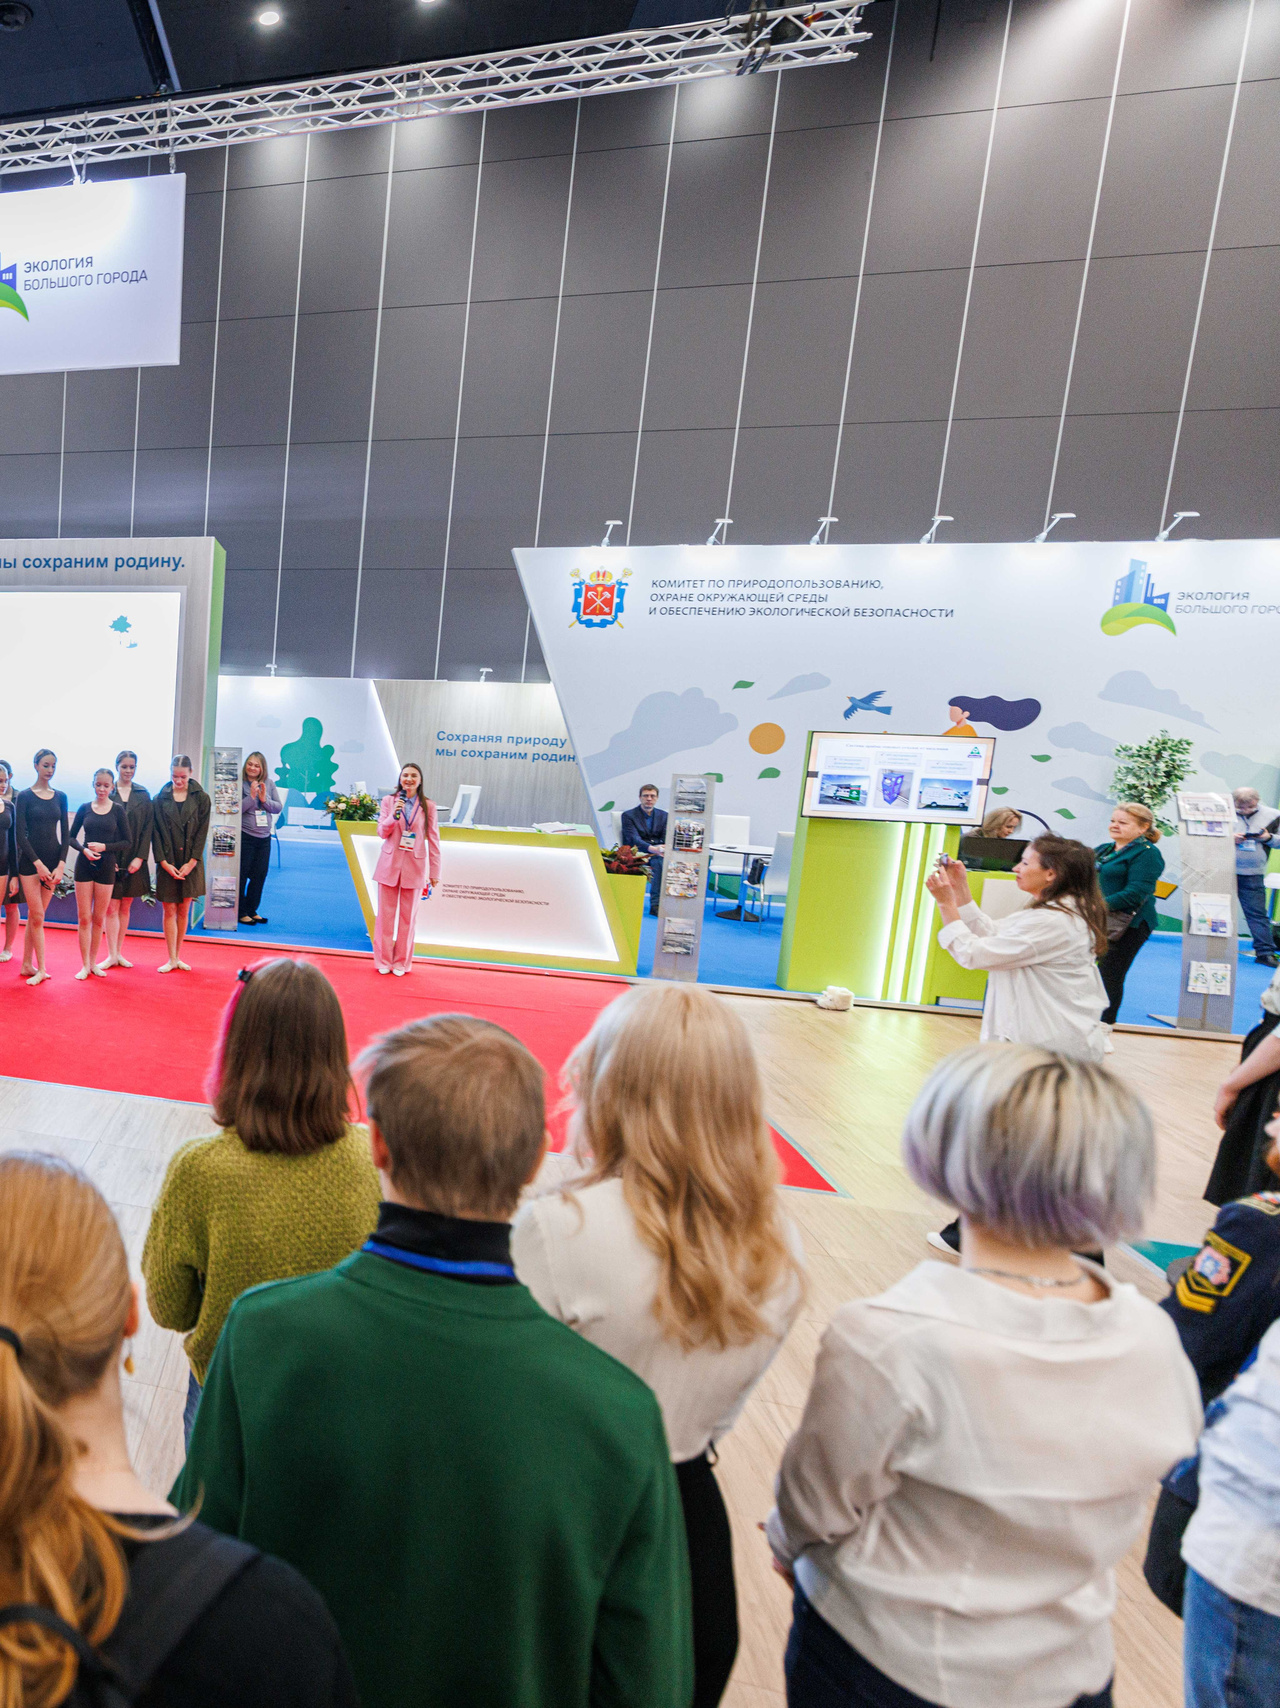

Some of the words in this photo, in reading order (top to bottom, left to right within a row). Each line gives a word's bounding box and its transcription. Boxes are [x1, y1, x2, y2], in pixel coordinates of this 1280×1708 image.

[24, 256, 93, 273] ЭКОЛОГИЯ
[24, 274, 94, 291] БОЛЬШОГО
[96, 270, 148, 284] ГОРОДА
[22, 556, 108, 572] сохраним
[114, 556, 185, 572] родину.
[651, 580, 706, 588] КОМИТЕТ
[708, 580, 725, 588] ПО
[727, 580, 884, 590] ПРИРОДОПОЛЬЗОВАНИЮ,
[650, 593, 694, 602] ОХРАНЕ
[696, 592, 784, 603] ОКРУЖАЮЩЕЙ
[786, 594, 828, 603] СРЕДЫ
[1177, 592, 1250, 600] ЭКОЛОГИЯ
[648, 606, 657, 616] И
[660, 606, 746, 616] ОБЕСПЕЧЕНИЮ
[748, 606, 850, 618] ЭКОЛОГИЧЕСКОЙ
[853, 608, 954, 618] БЕЗОПАСНОСТИ
[1175, 604, 1248, 614] БОЛЬШОГО
[436, 730, 502, 744] Сохраняя
[506, 735, 568, 748] природу
[436, 748, 456, 756] мы
[460, 748, 528, 760] сохраним
[532, 753, 578, 765] родин
